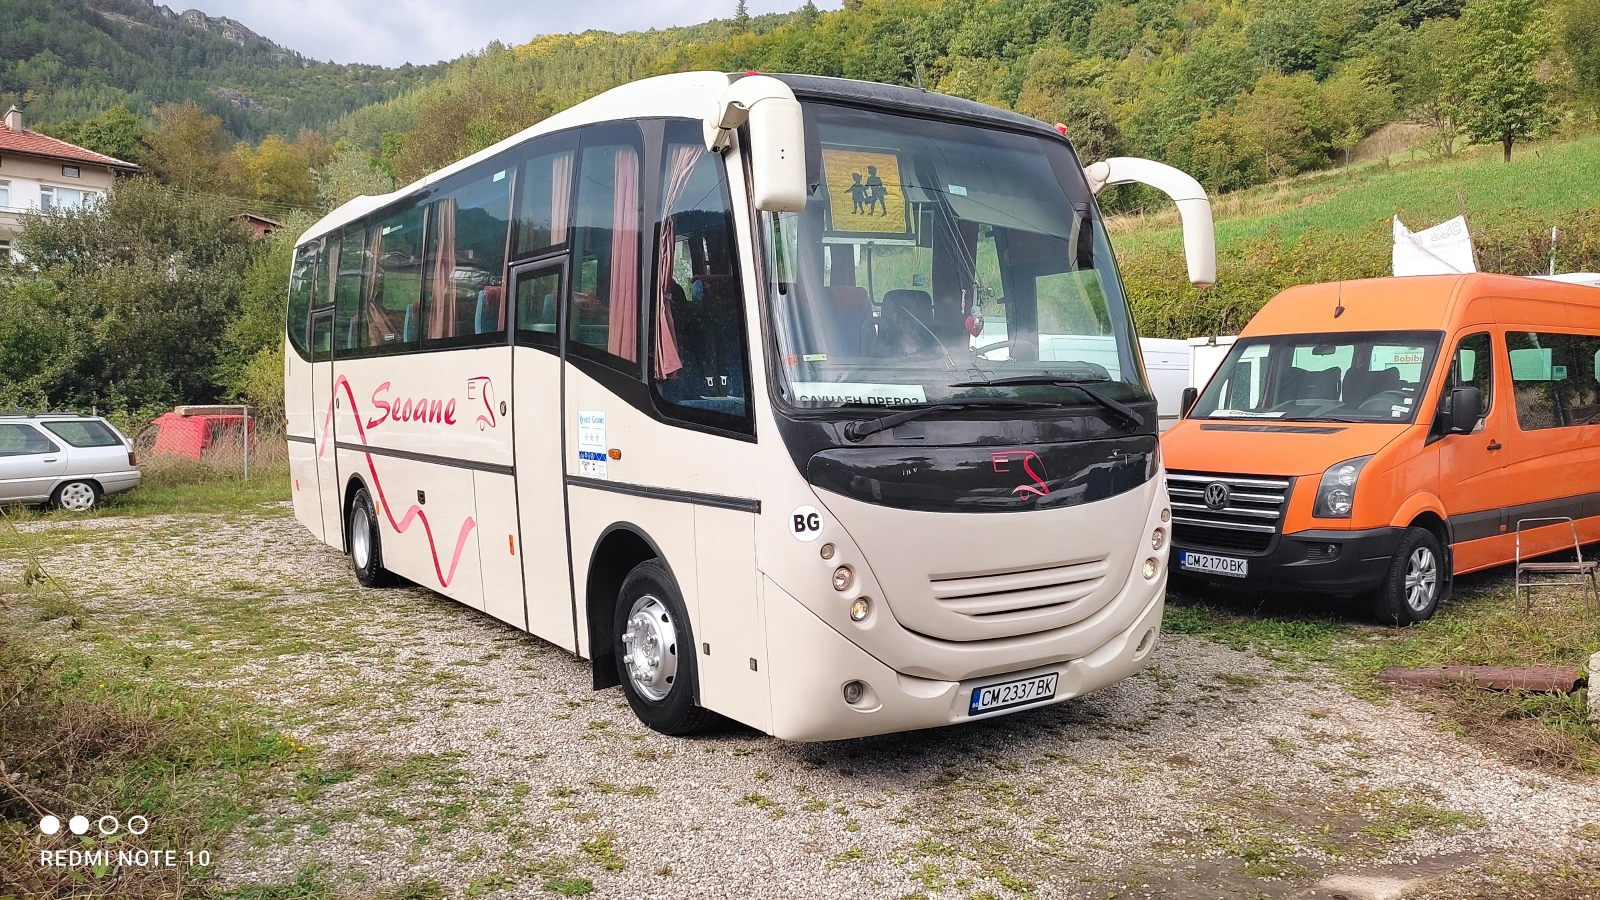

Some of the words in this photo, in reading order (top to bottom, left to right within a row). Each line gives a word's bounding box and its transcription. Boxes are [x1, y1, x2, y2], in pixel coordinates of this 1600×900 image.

[366, 381, 457, 429] Seoane
[794, 513, 820, 532] BG
[1187, 554, 1200, 566] CM
[1202, 557, 1228, 570] 2170
[1230, 560, 1244, 573] BK
[981, 688, 1001, 706] CM
[1002, 681, 1035, 702] 2337
[1036, 678, 1053, 695] BK
